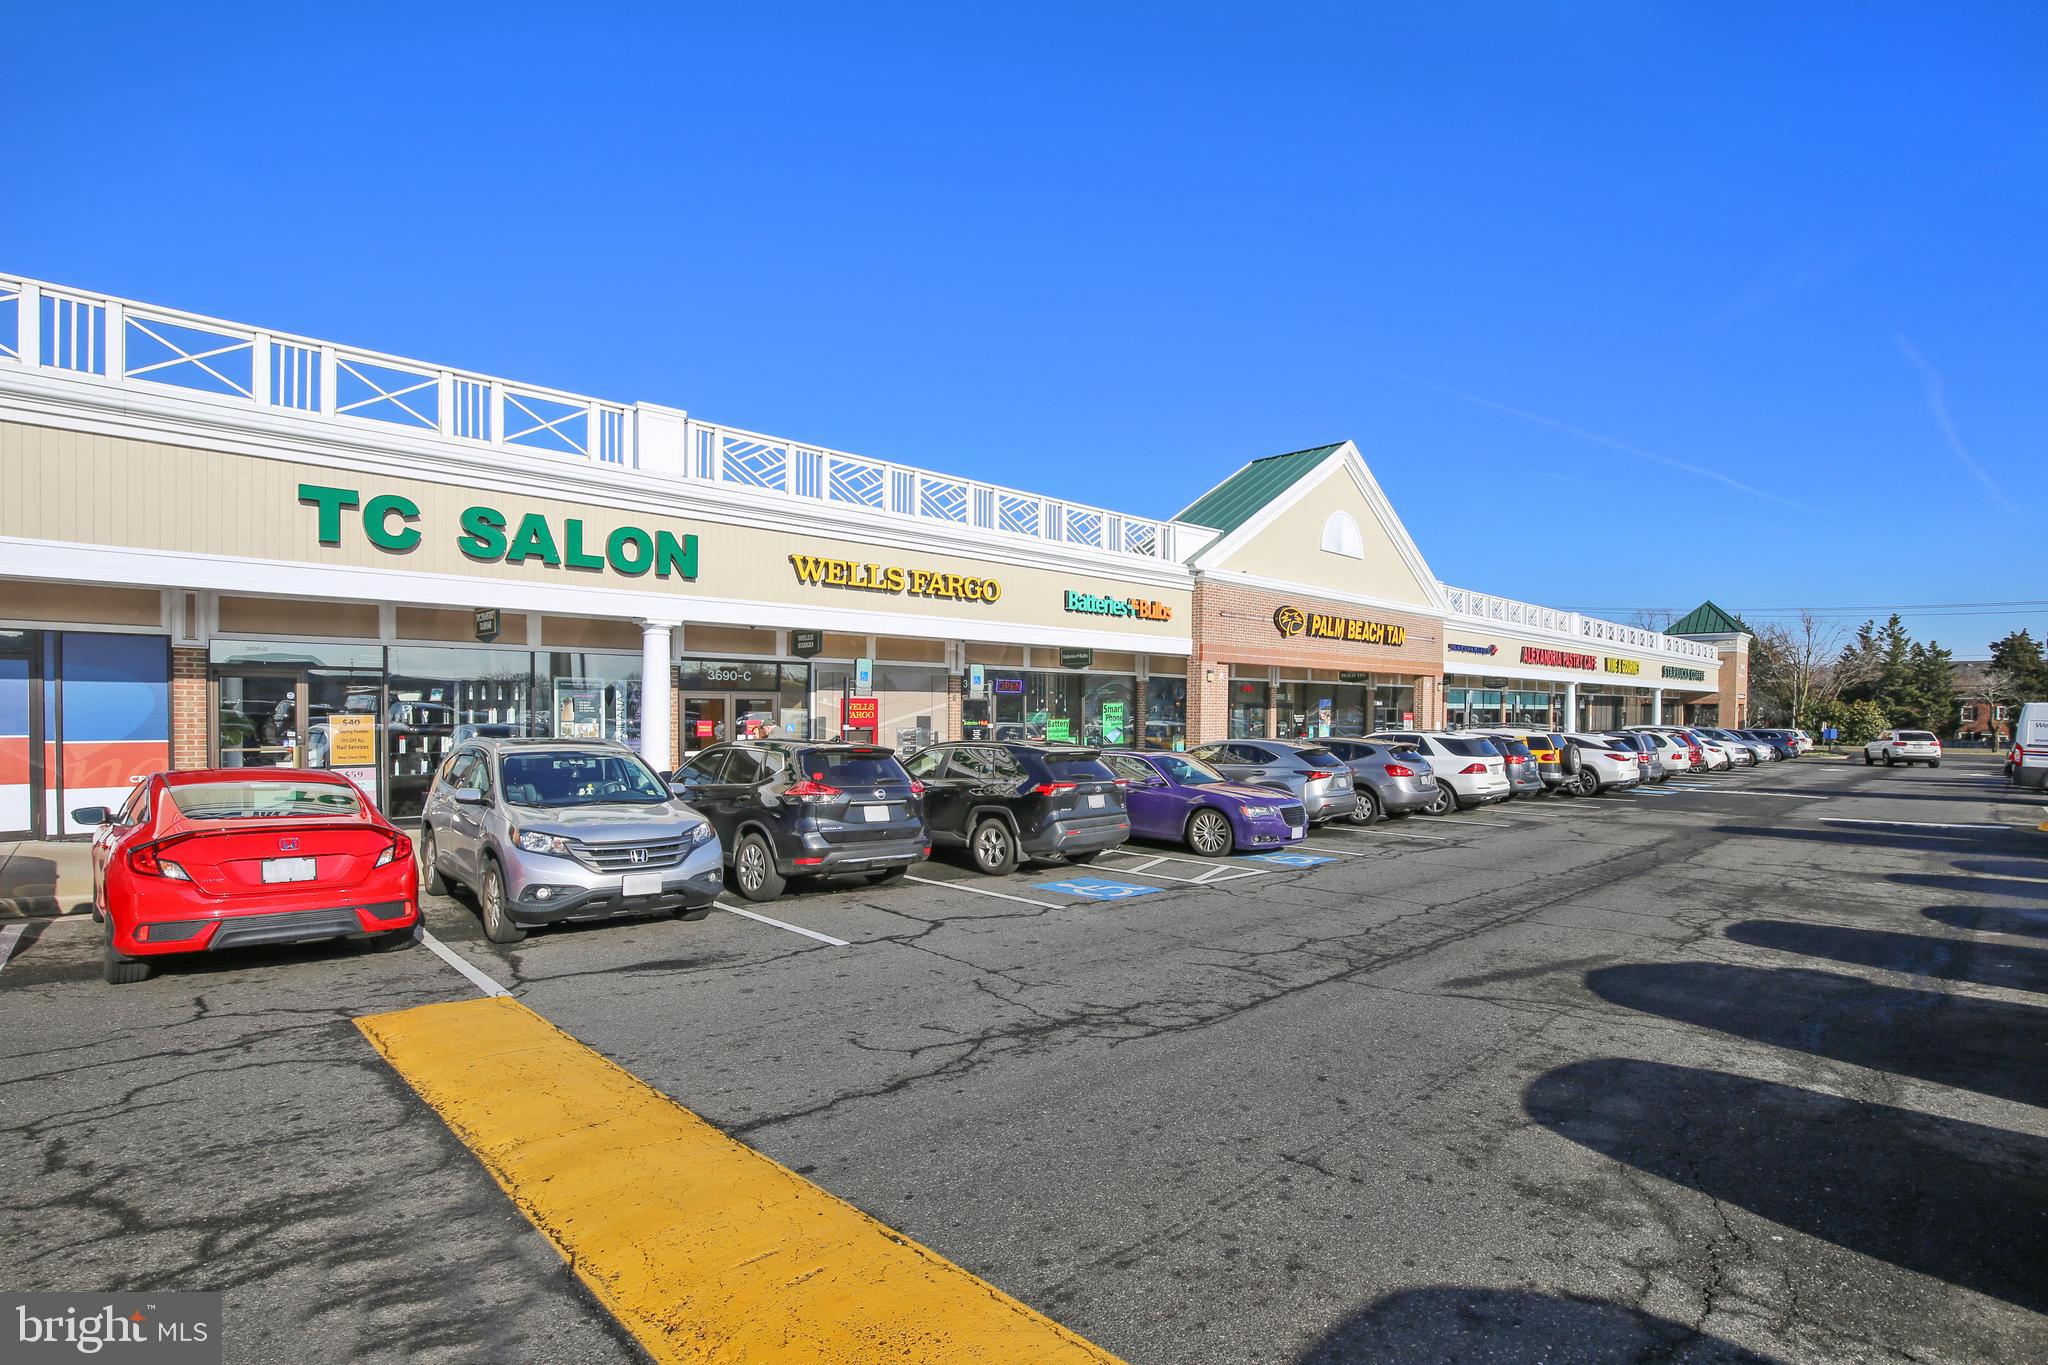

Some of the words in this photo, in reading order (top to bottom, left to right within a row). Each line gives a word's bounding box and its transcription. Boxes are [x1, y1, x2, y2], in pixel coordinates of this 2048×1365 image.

[298, 484, 422, 553] TC
[457, 506, 699, 582] SALON
[789, 554, 906, 594] WELLS
[908, 569, 1002, 604] FARGO
[1308, 613, 1346, 639] PALM
[1347, 619, 1385, 645] BEACH
[1386, 624, 1407, 647] TAN
[1522, 646, 1562, 667] ALEXANDRIA
[1563, 651, 1583, 669] PASTRY
[708, 670, 752, 681] 3690-C
[998, 681, 1020, 692] OPEN
[1103, 704, 1124, 713] Smart
[848, 711, 875, 719] ARGO
[342, 719, 360, 727] $40
[1047, 720, 1069, 729] Battery
